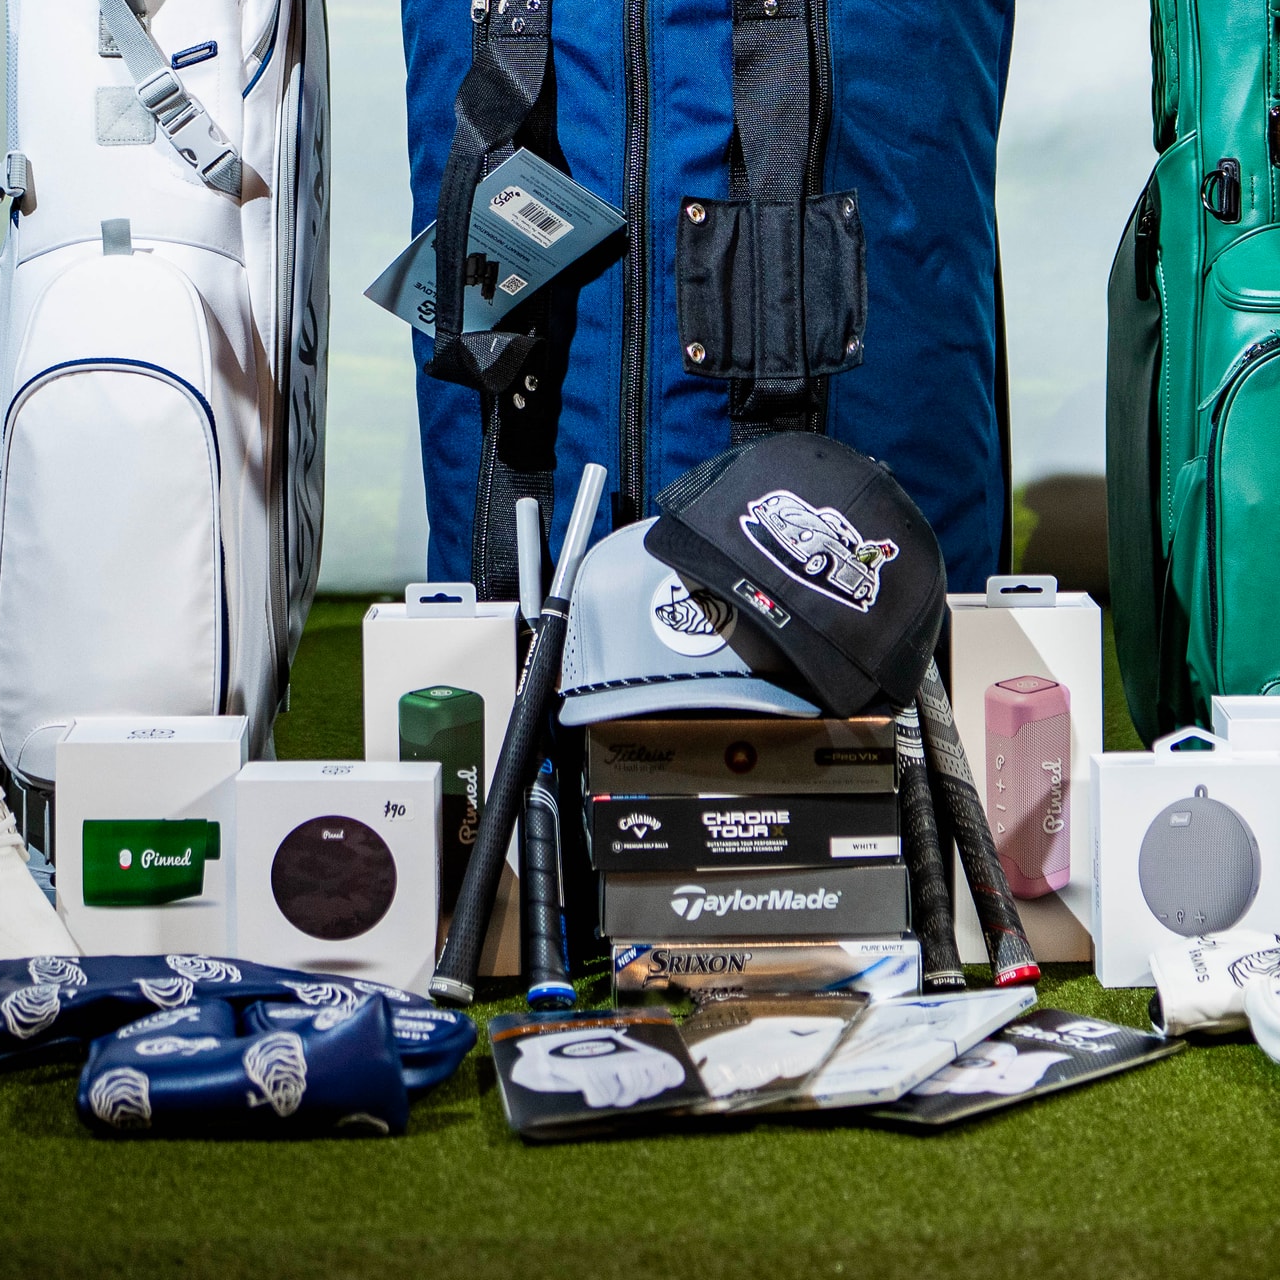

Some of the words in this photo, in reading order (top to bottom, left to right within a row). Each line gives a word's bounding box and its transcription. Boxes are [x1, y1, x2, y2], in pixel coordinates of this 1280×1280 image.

[471, 221, 506, 246] INFORMATION
[503, 242, 531, 263] WARRANTY
[413, 279, 438, 300] LOVE
[458, 765, 477, 845] Pinned
[1043, 757, 1065, 835] Pinned
[384, 801, 406, 818] $90
[703, 811, 790, 825] CHROME
[618, 812, 662, 831] Callaway
[708, 825, 769, 838] TOUR
[772, 825, 784, 836] X
[323, 829, 344, 840] Pinned
[141, 848, 192, 869] Pinned
[671, 885, 842, 920] TaylorMade
[617, 946, 638, 968] NEW
[861, 944, 881, 952] PURE
[649, 949, 752, 974] SRIXON
